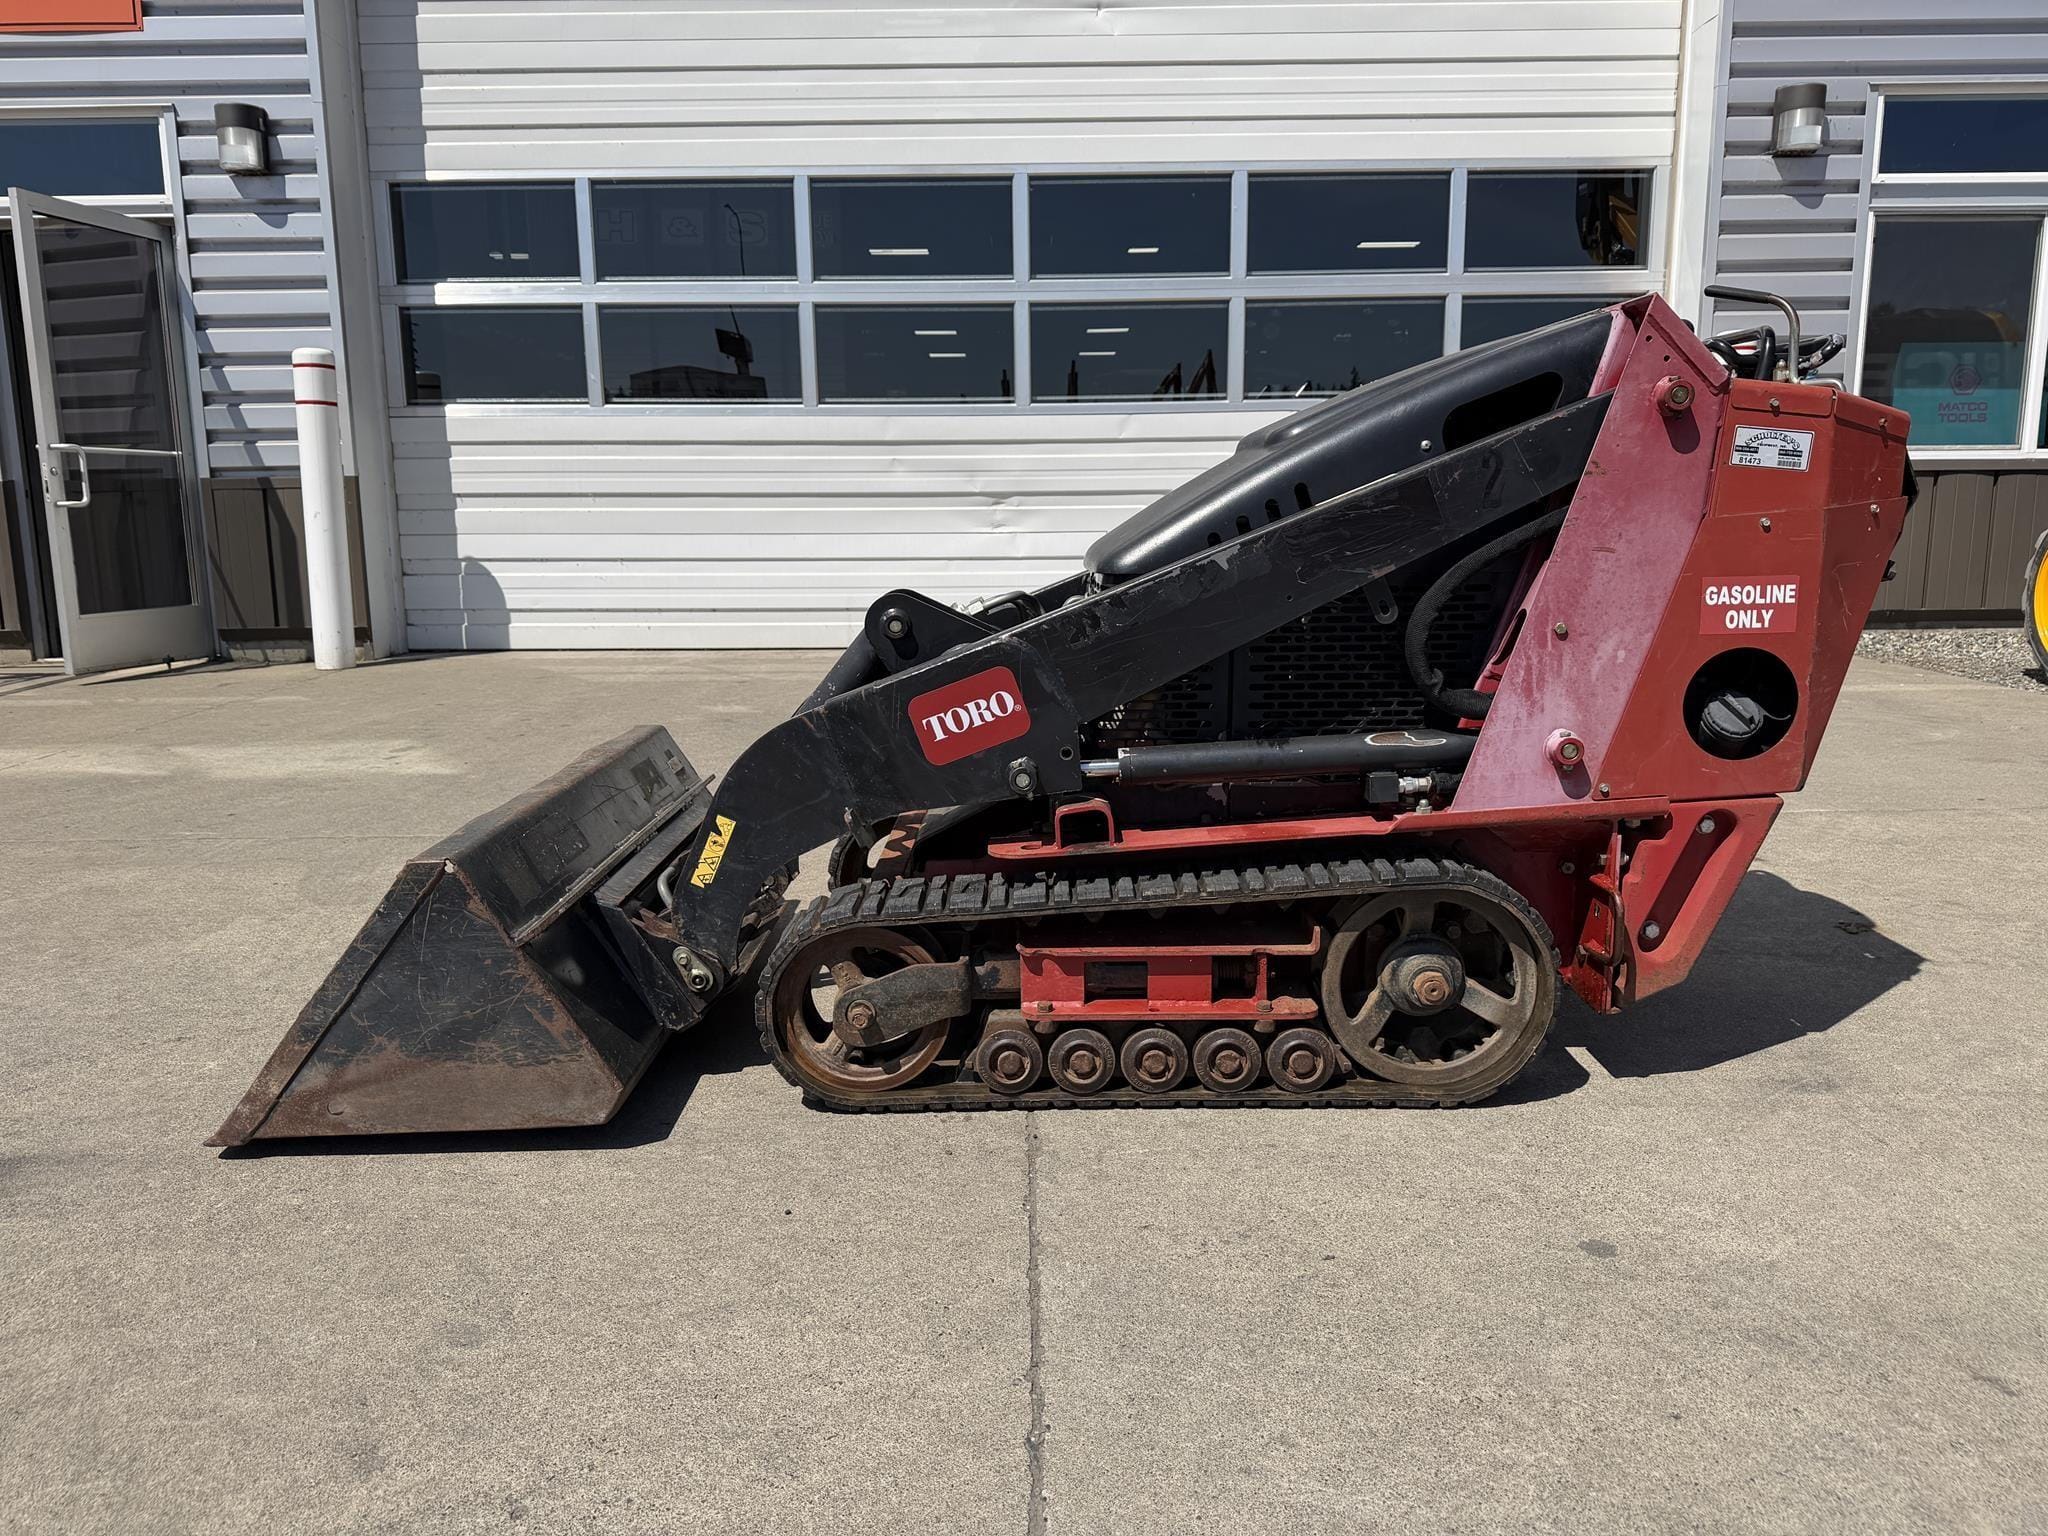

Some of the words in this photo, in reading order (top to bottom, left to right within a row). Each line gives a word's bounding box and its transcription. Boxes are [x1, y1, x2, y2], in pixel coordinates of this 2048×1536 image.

[1938, 401, 1988, 412] MATCO
[1938, 413, 1988, 423] TOOLS
[1739, 457, 1761, 465] 81473
[1705, 584, 1797, 605] GASOLINE
[1725, 609, 1774, 629] ONLY
[922, 690, 1015, 741] TORO
